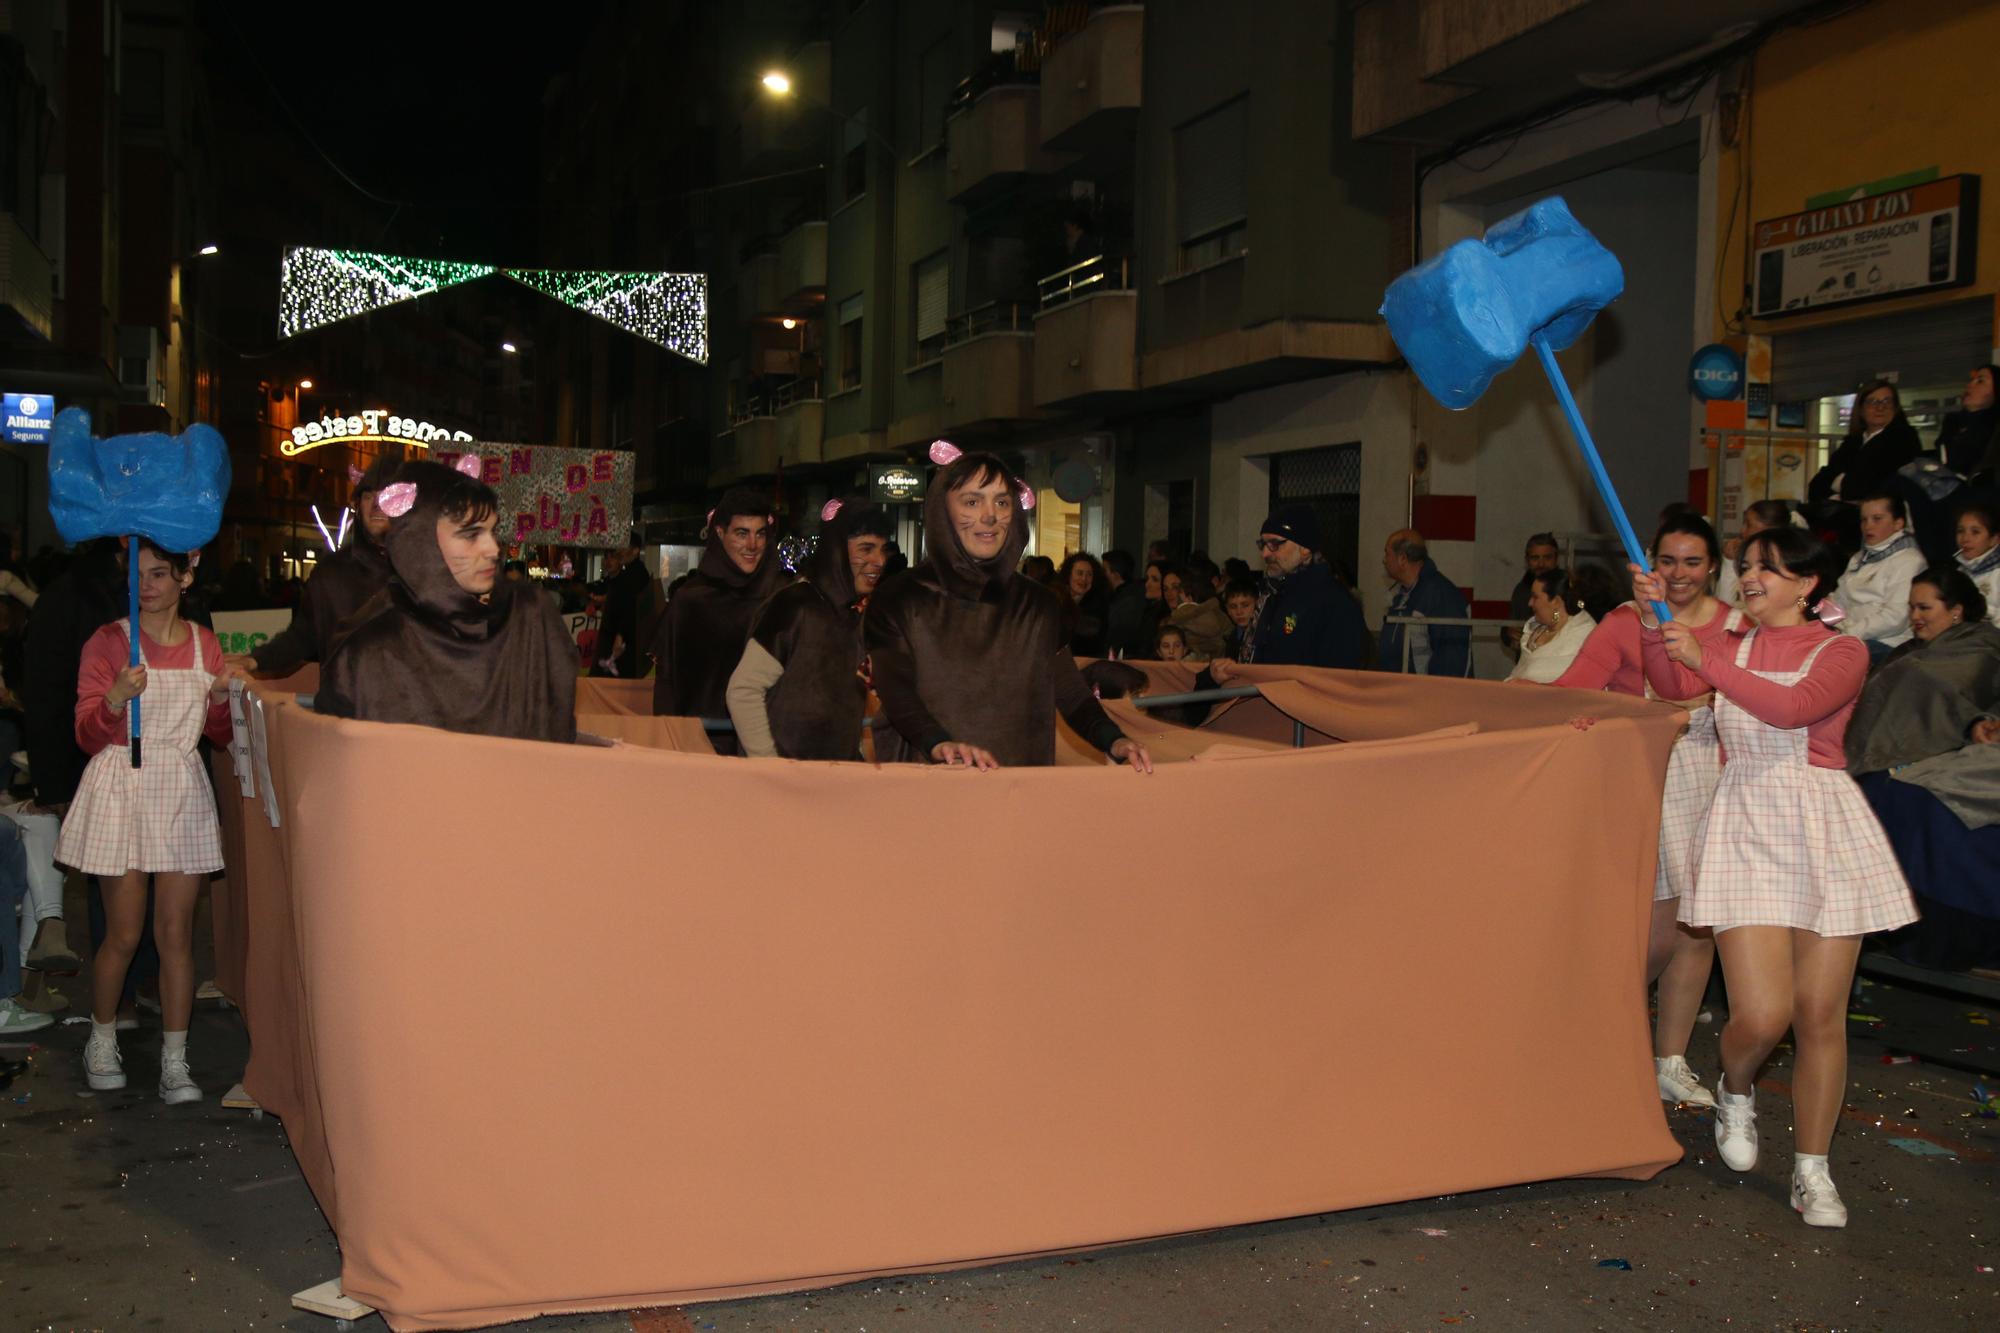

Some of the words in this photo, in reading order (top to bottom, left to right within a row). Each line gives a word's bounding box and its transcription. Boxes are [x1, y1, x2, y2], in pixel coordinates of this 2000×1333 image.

[1794, 201, 1868, 237] GALAXY
[1693, 368, 1739, 382] DIGI
[6, 415, 51, 429] Allianz
[12, 431, 44, 442] Seguros
[565, 453, 616, 493] DE
[515, 495, 608, 541] PUJÀ
